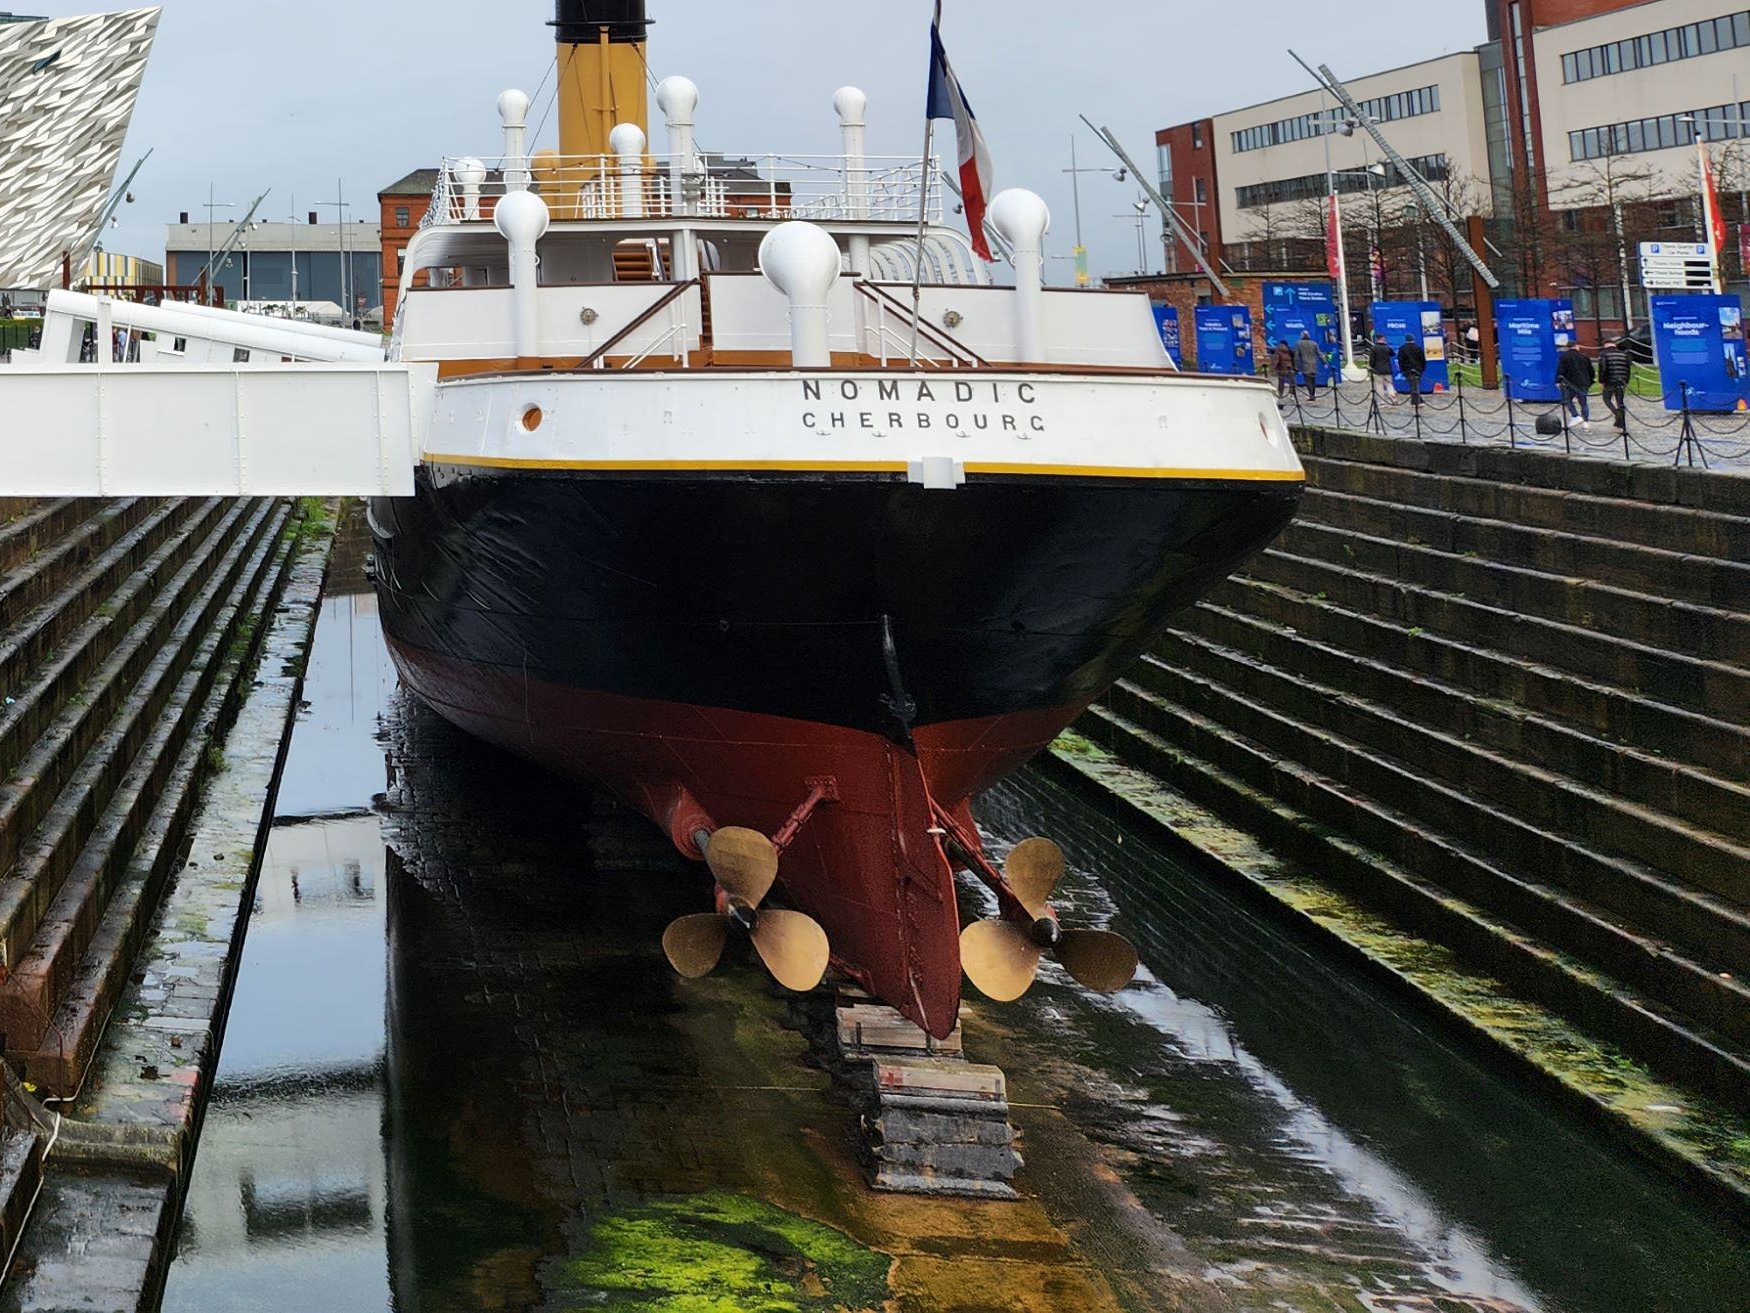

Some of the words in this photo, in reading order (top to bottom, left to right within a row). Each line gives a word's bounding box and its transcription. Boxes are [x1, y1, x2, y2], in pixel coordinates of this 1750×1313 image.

[1662, 322, 1710, 330] Neighbour-
[802, 379, 1036, 404] NOMADIC
[802, 412, 1045, 432] CHERBOURG
